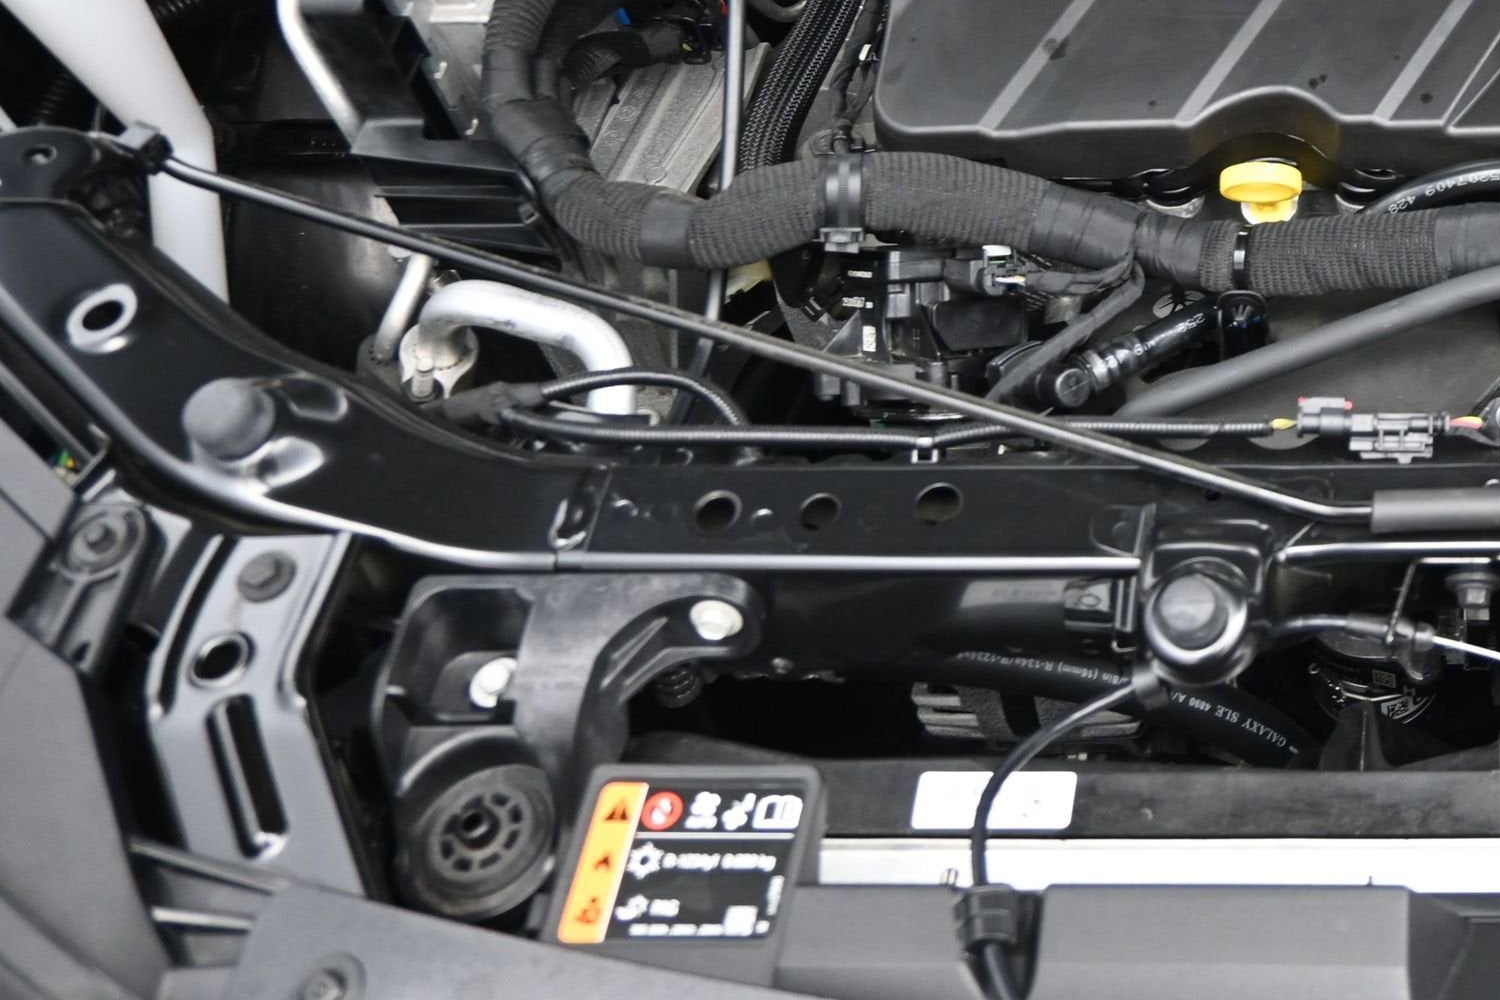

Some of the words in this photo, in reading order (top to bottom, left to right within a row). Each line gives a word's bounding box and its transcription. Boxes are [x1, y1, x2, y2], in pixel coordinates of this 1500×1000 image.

[1387, 194, 1416, 215] 428
[1215, 703, 1240, 722] SLE
[1242, 717, 1288, 749] GALAXY
